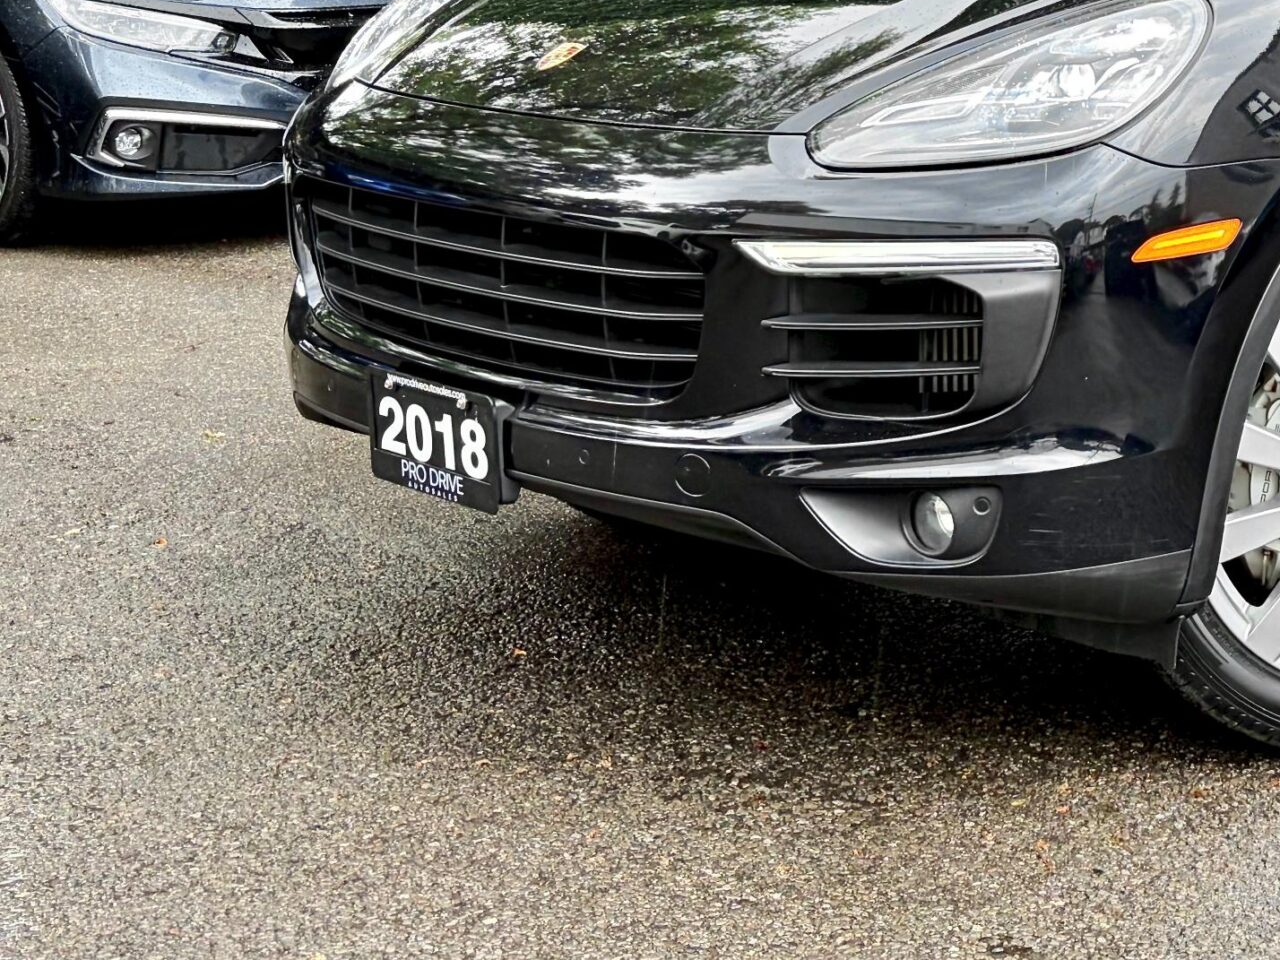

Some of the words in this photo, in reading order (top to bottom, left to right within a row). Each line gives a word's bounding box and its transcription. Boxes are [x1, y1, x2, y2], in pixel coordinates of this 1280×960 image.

[379, 396, 489, 480] 2018
[401, 459, 427, 483] PRO
[429, 467, 464, 495] DRIVE
[408, 481, 458, 502] AUTOSALES
